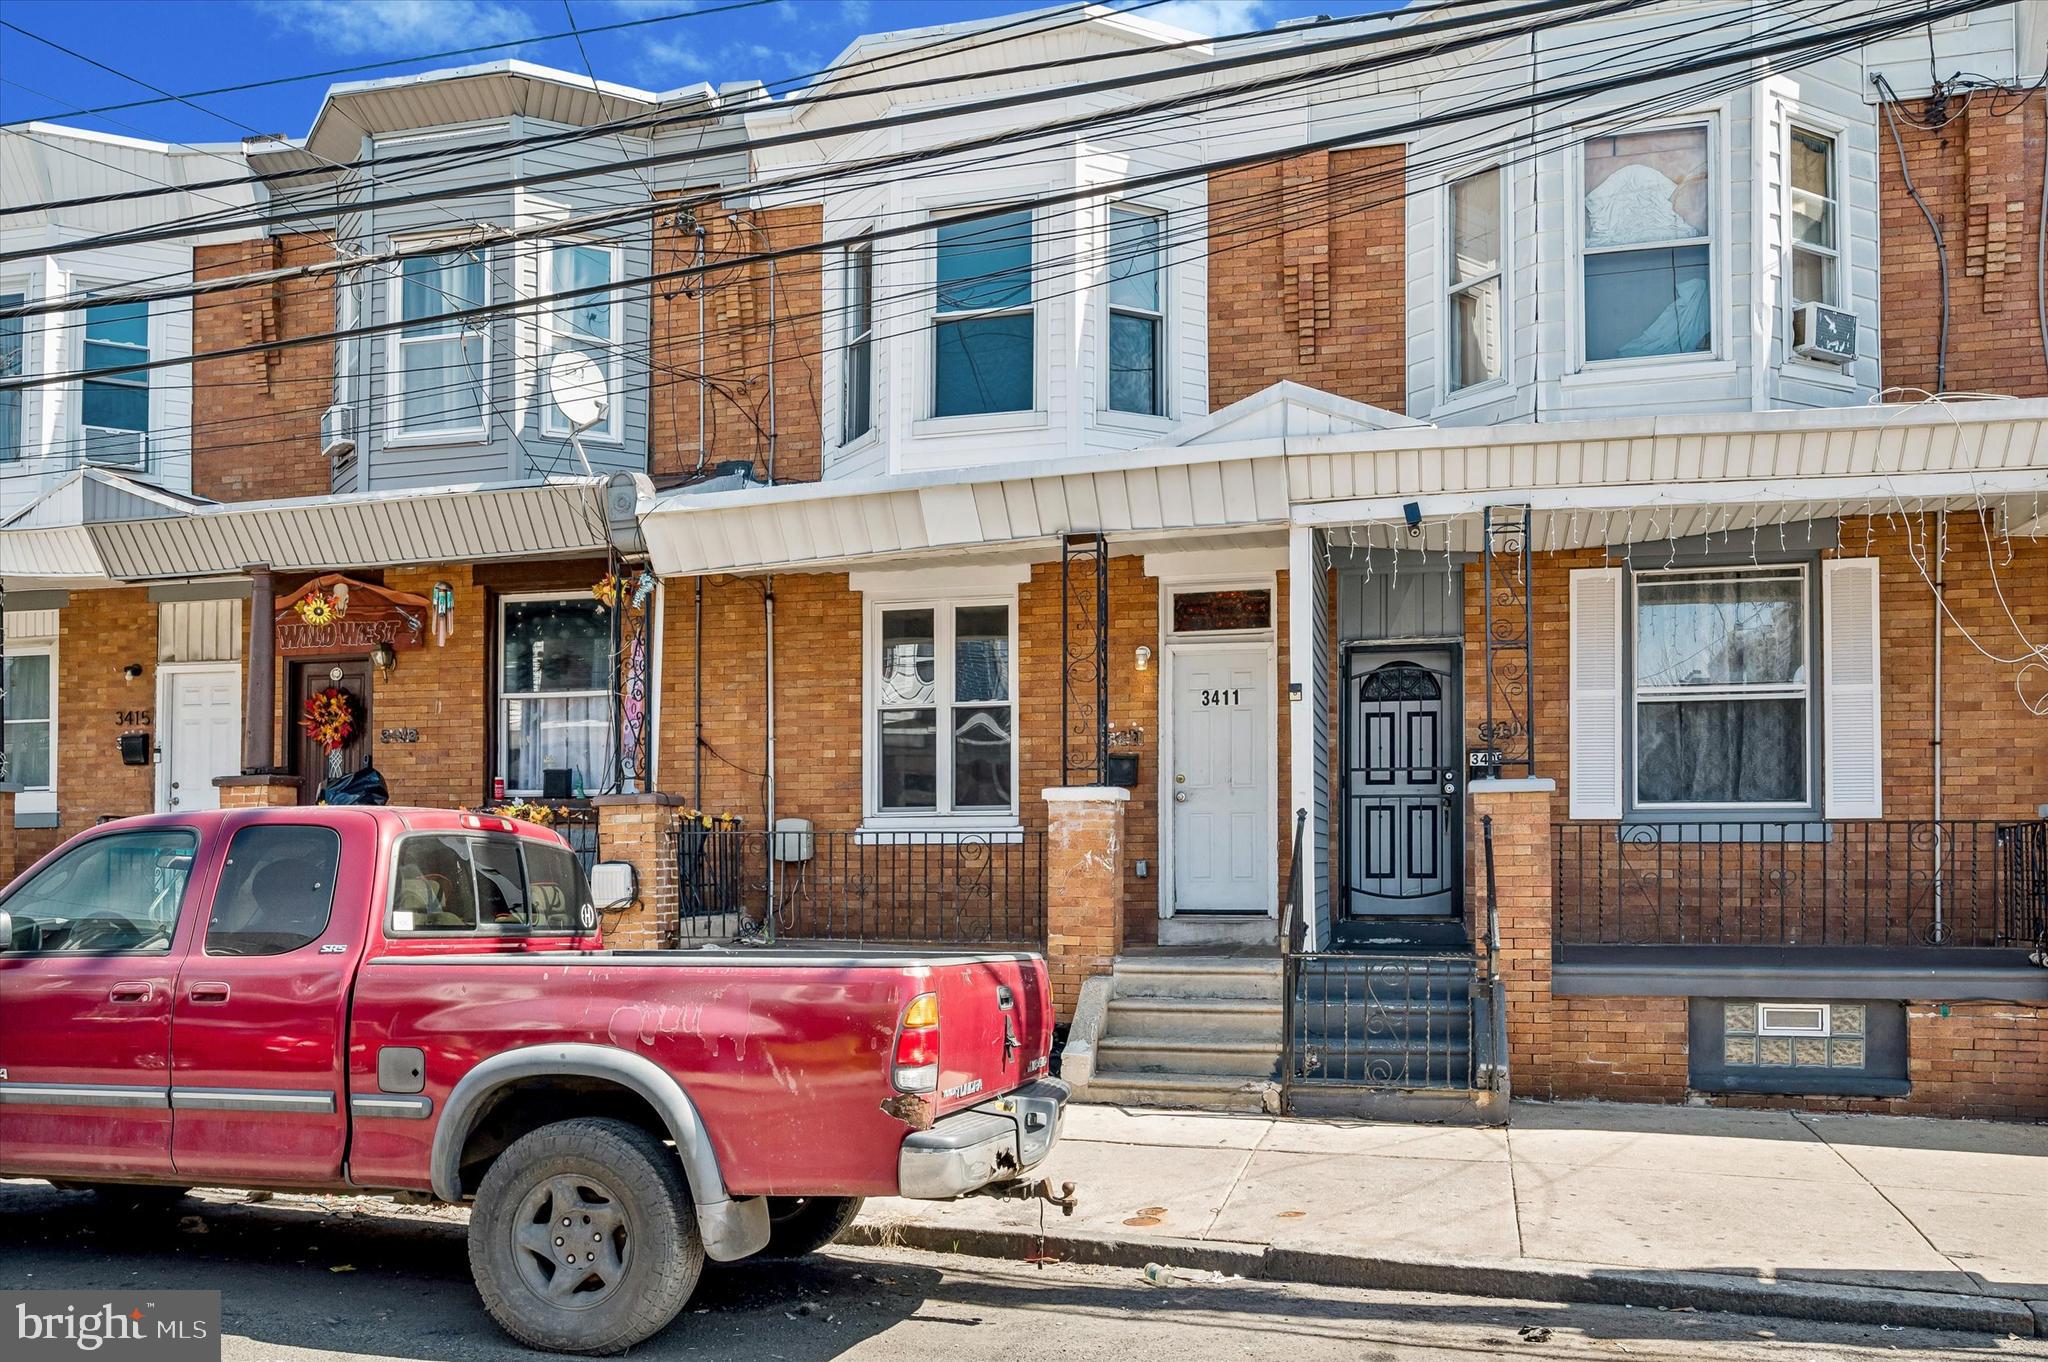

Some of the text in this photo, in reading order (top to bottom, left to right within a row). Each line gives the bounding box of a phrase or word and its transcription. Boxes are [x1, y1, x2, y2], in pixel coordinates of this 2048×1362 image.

[277, 620, 402, 649] WILD WEST
[1201, 688, 1239, 706] 3411
[115, 710, 151, 726] 3415
[320, 944, 348, 953] SR5
